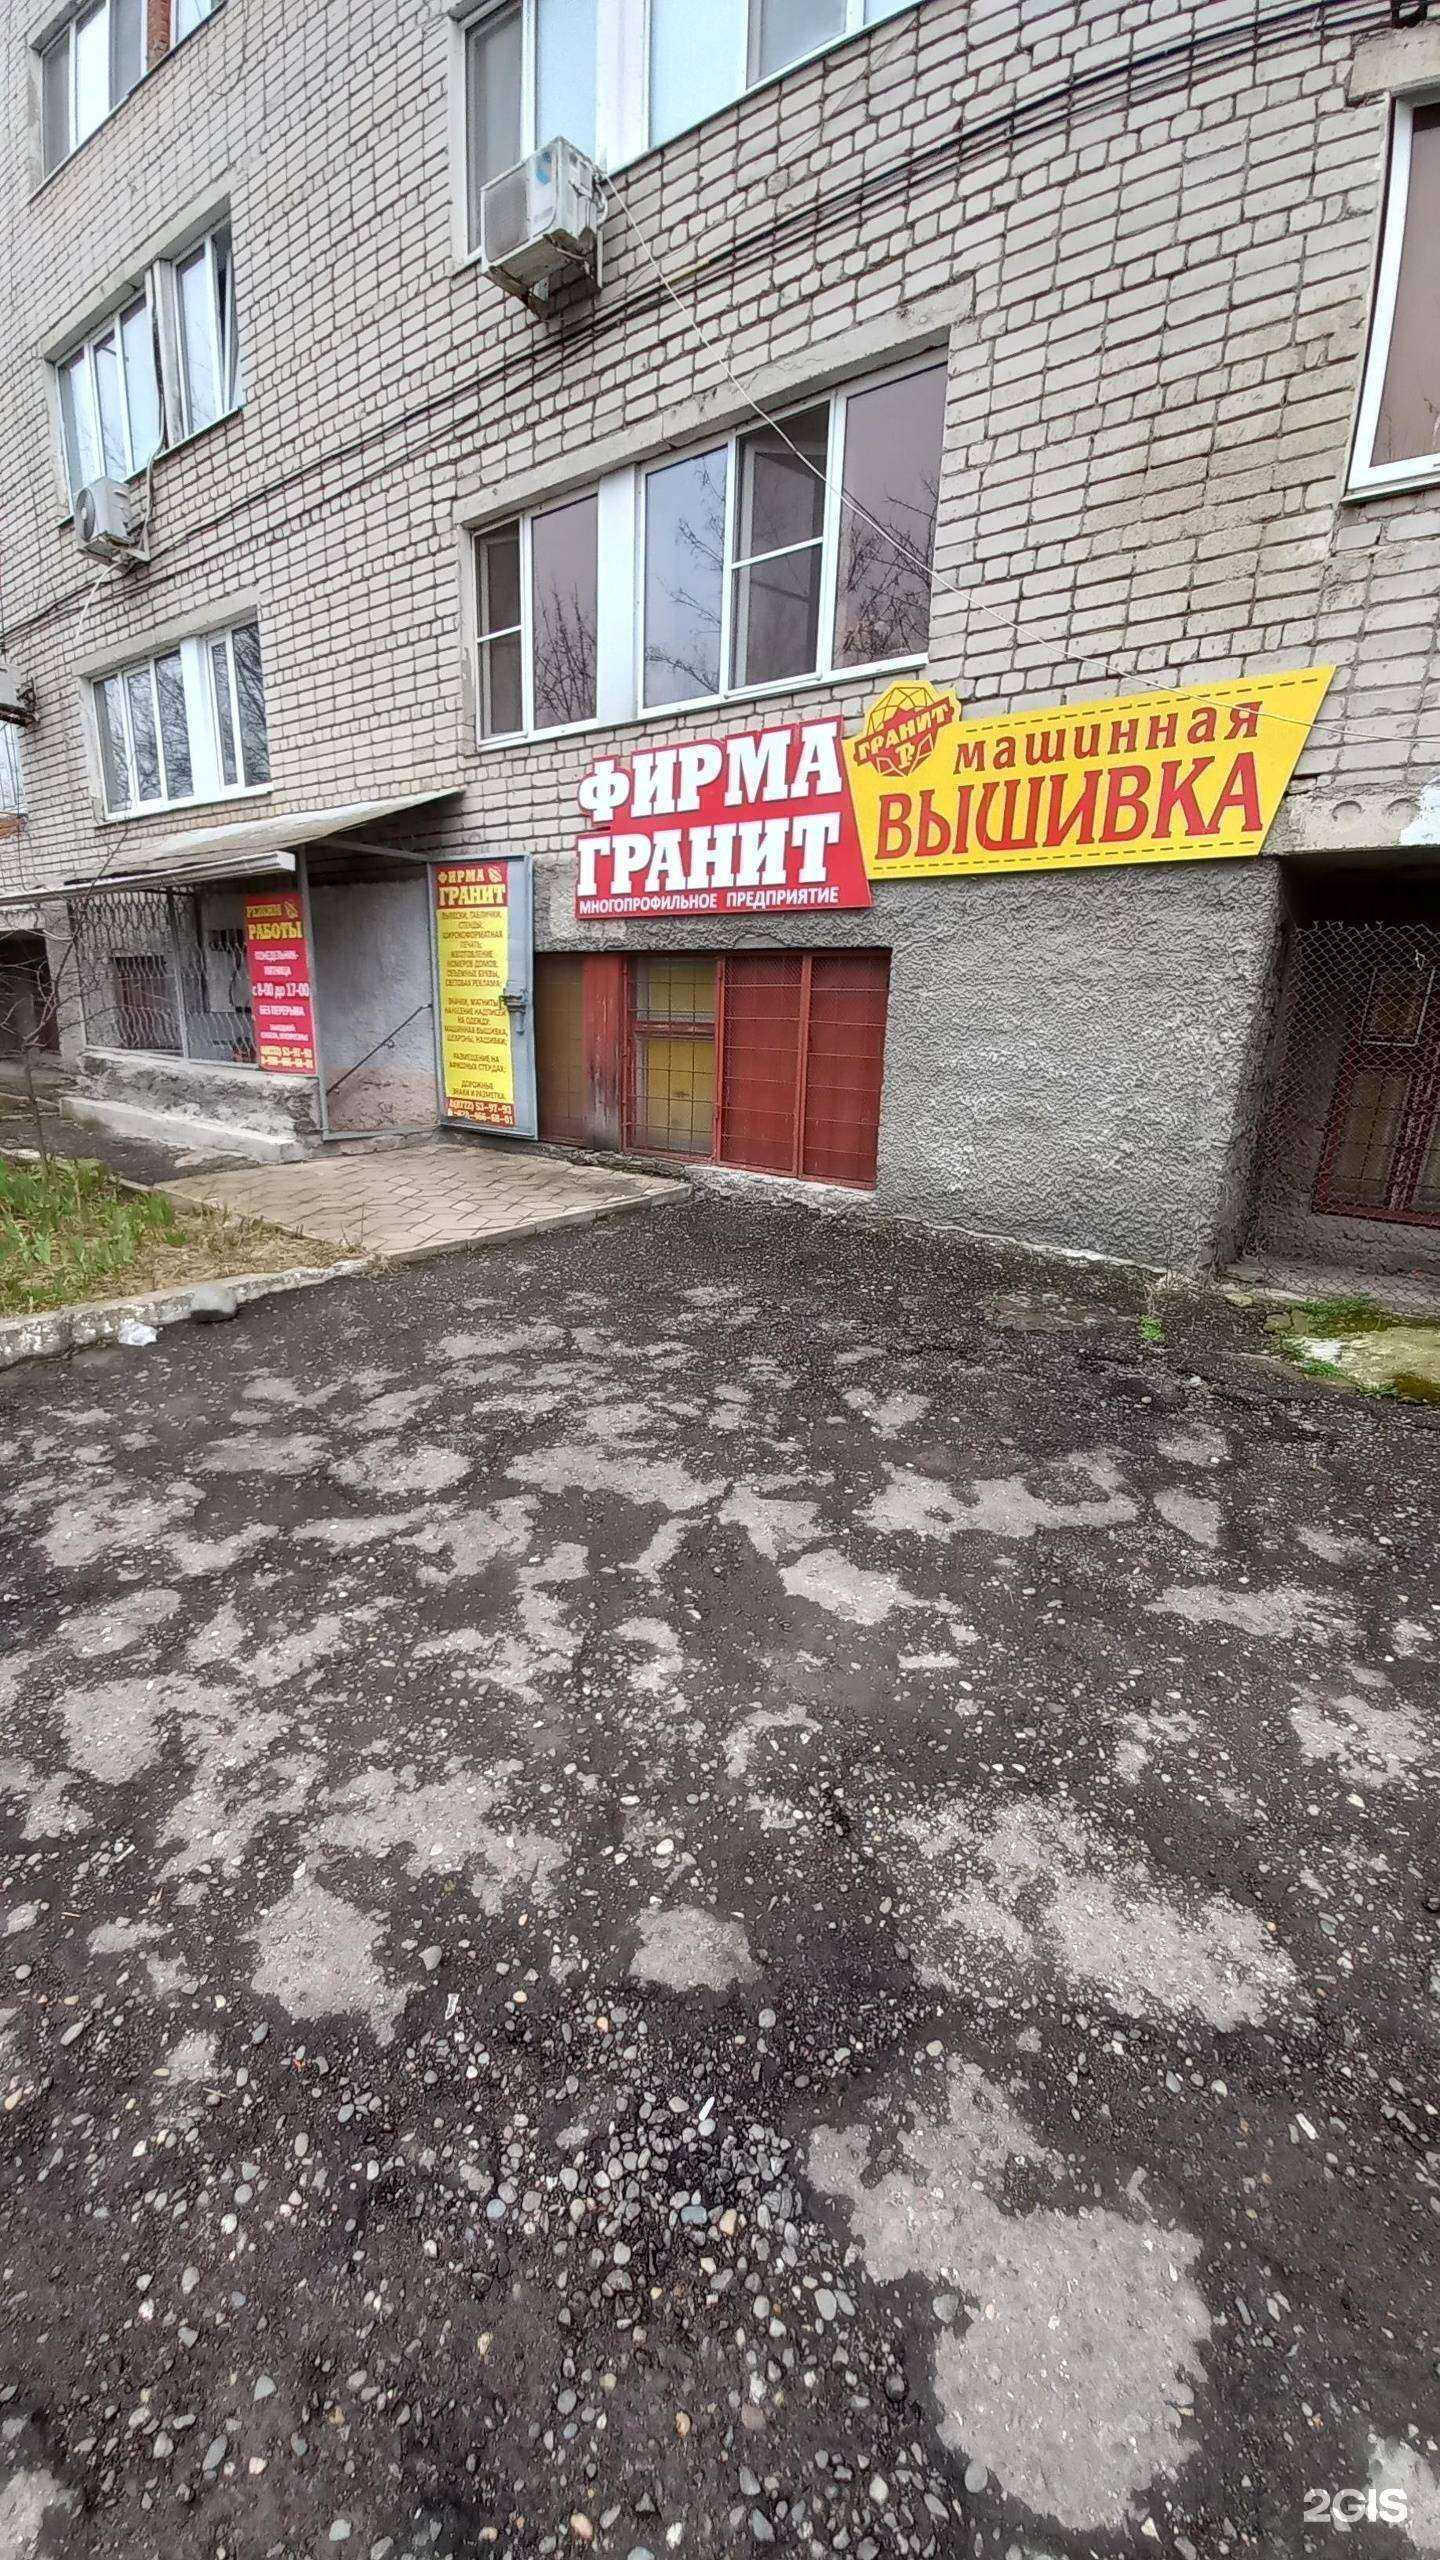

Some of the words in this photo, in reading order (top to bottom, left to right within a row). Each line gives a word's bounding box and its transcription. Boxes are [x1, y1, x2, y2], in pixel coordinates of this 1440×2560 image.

[858, 703, 949, 761] ГРАНИТ
[953, 700, 1264, 776] машинная
[578, 721, 843, 823] ФИРМА
[875, 752, 1264, 861] ВЫШИВКА
[577, 811, 842, 897] ГРАНИТ
[438, 868, 485, 884] ФИРМА
[438, 884, 506, 906] ГРАНИТ
[579, 892, 718, 915] МНОГОПРОФИЛЬНОЕ
[726, 886, 840, 911] ПРЕДПРИЯТИЕ
[247, 921, 303, 940] РАБОТЫ
[274, 985, 286, 999] до
